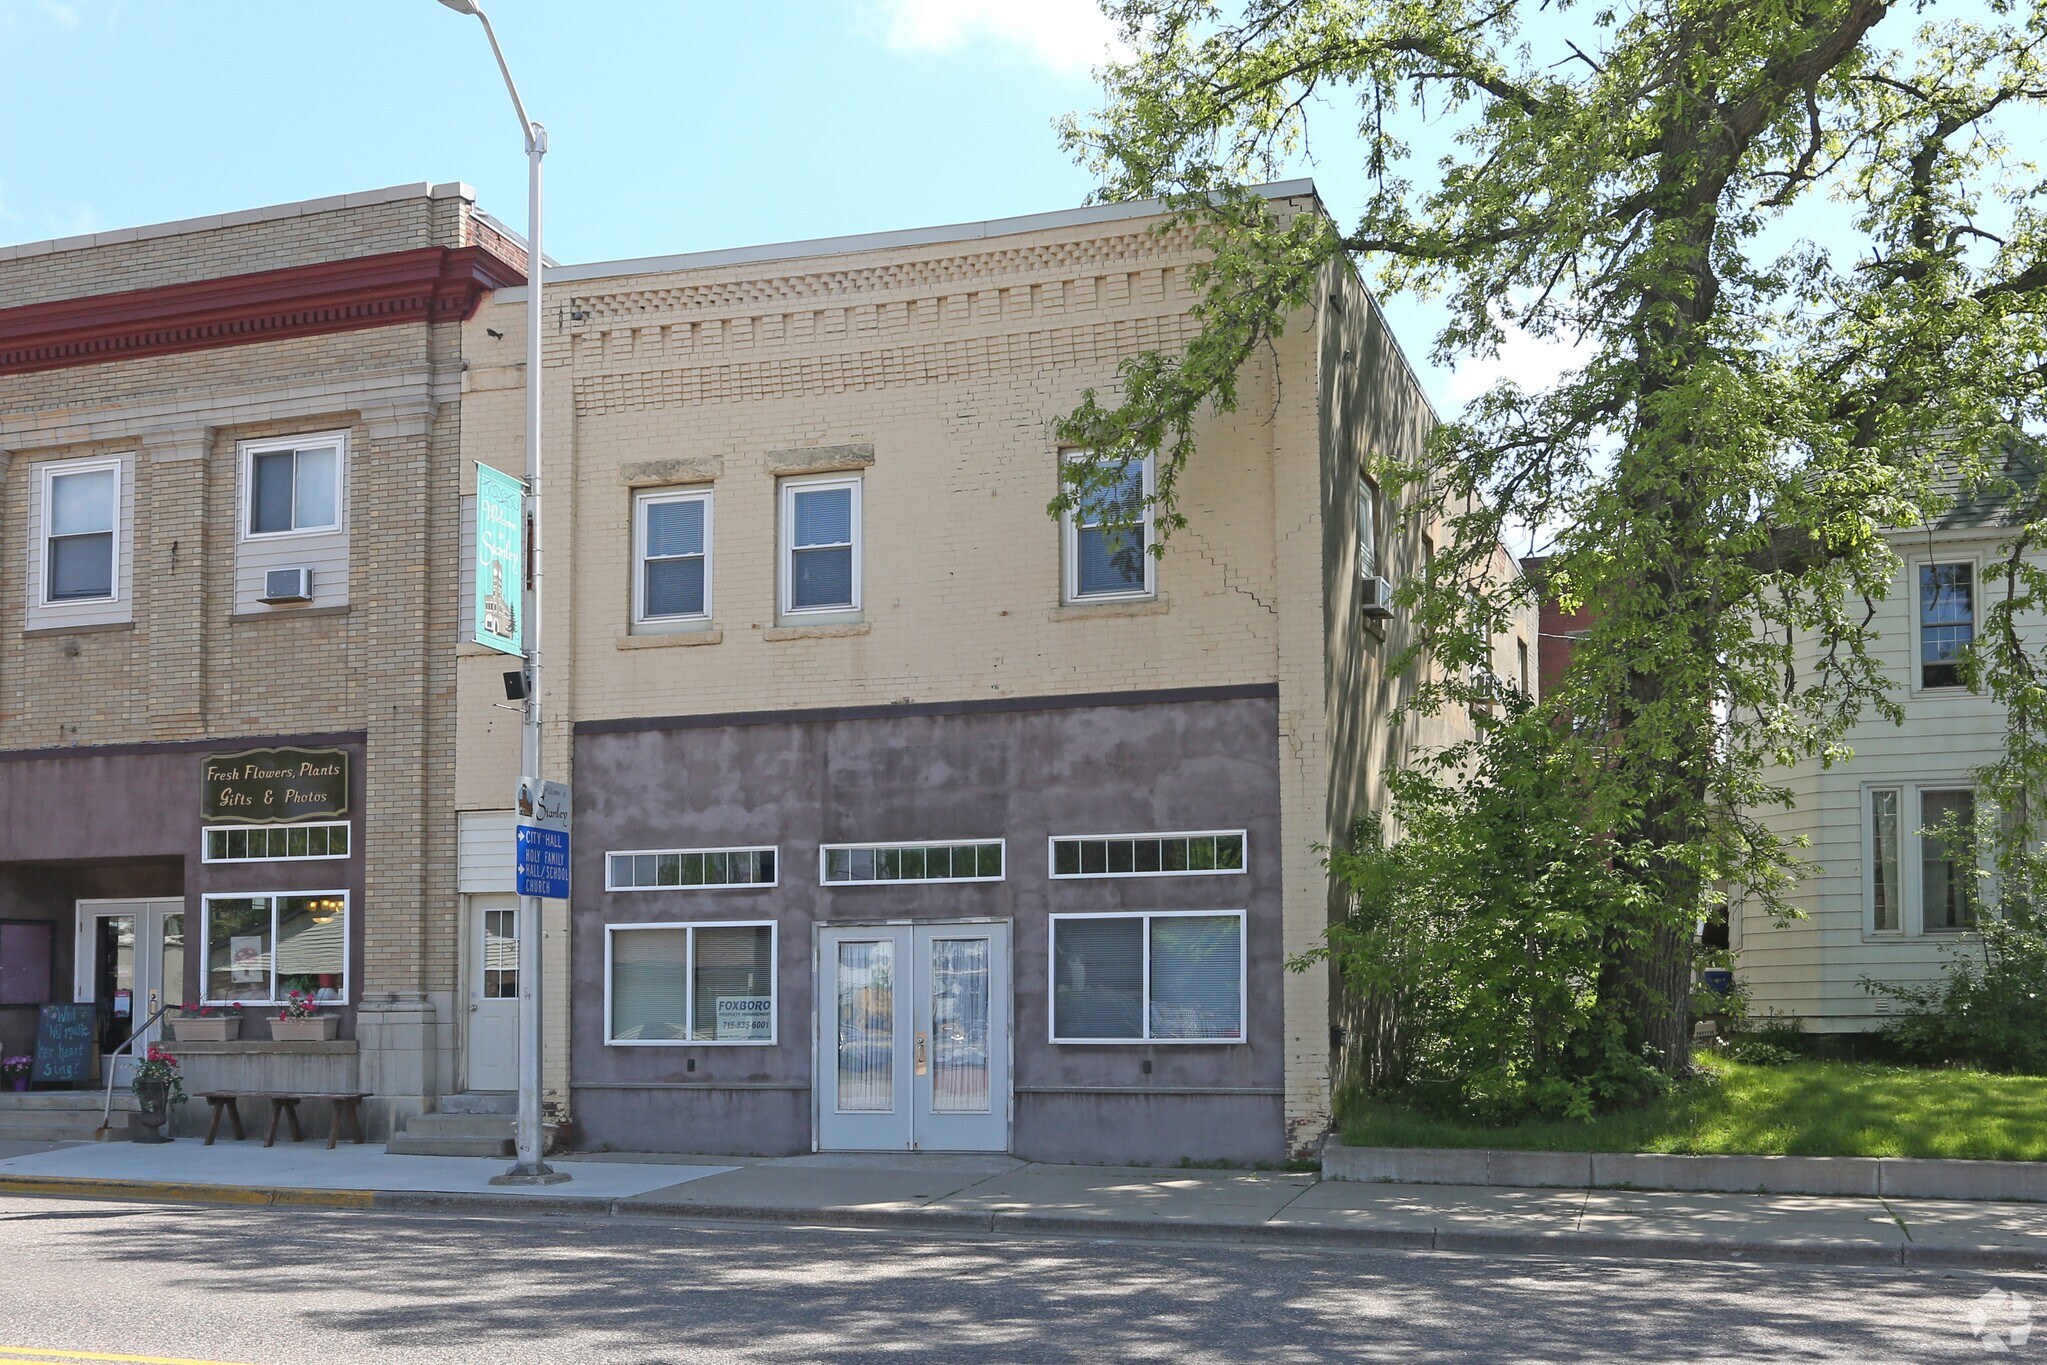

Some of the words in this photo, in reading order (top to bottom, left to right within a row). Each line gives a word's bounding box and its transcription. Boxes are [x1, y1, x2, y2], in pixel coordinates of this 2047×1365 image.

[482, 500, 517, 532] Welcome
[498, 530, 505, 541] to
[479, 531, 519, 574] Stanley
[207, 766, 239, 781] Fresh
[244, 764, 297, 780] Flowers,
[299, 762, 341, 777] Plants
[219, 788, 252, 806] Gifts
[264, 789, 274, 804] &
[284, 789, 327, 804] Photos
[536, 795, 568, 827] Stanley
[525, 830, 541, 845] CITY
[545, 834, 562, 848] HALL
[525, 848, 541, 862] HOLY
[544, 851, 565, 866] FAMILY
[525, 864, 569, 881] HALL/SCHOOL
[525, 879, 551, 894] CHURCH
[718, 1000, 771, 1011] FOXBORO
[722, 1021, 770, 1029] 715-835-6001
